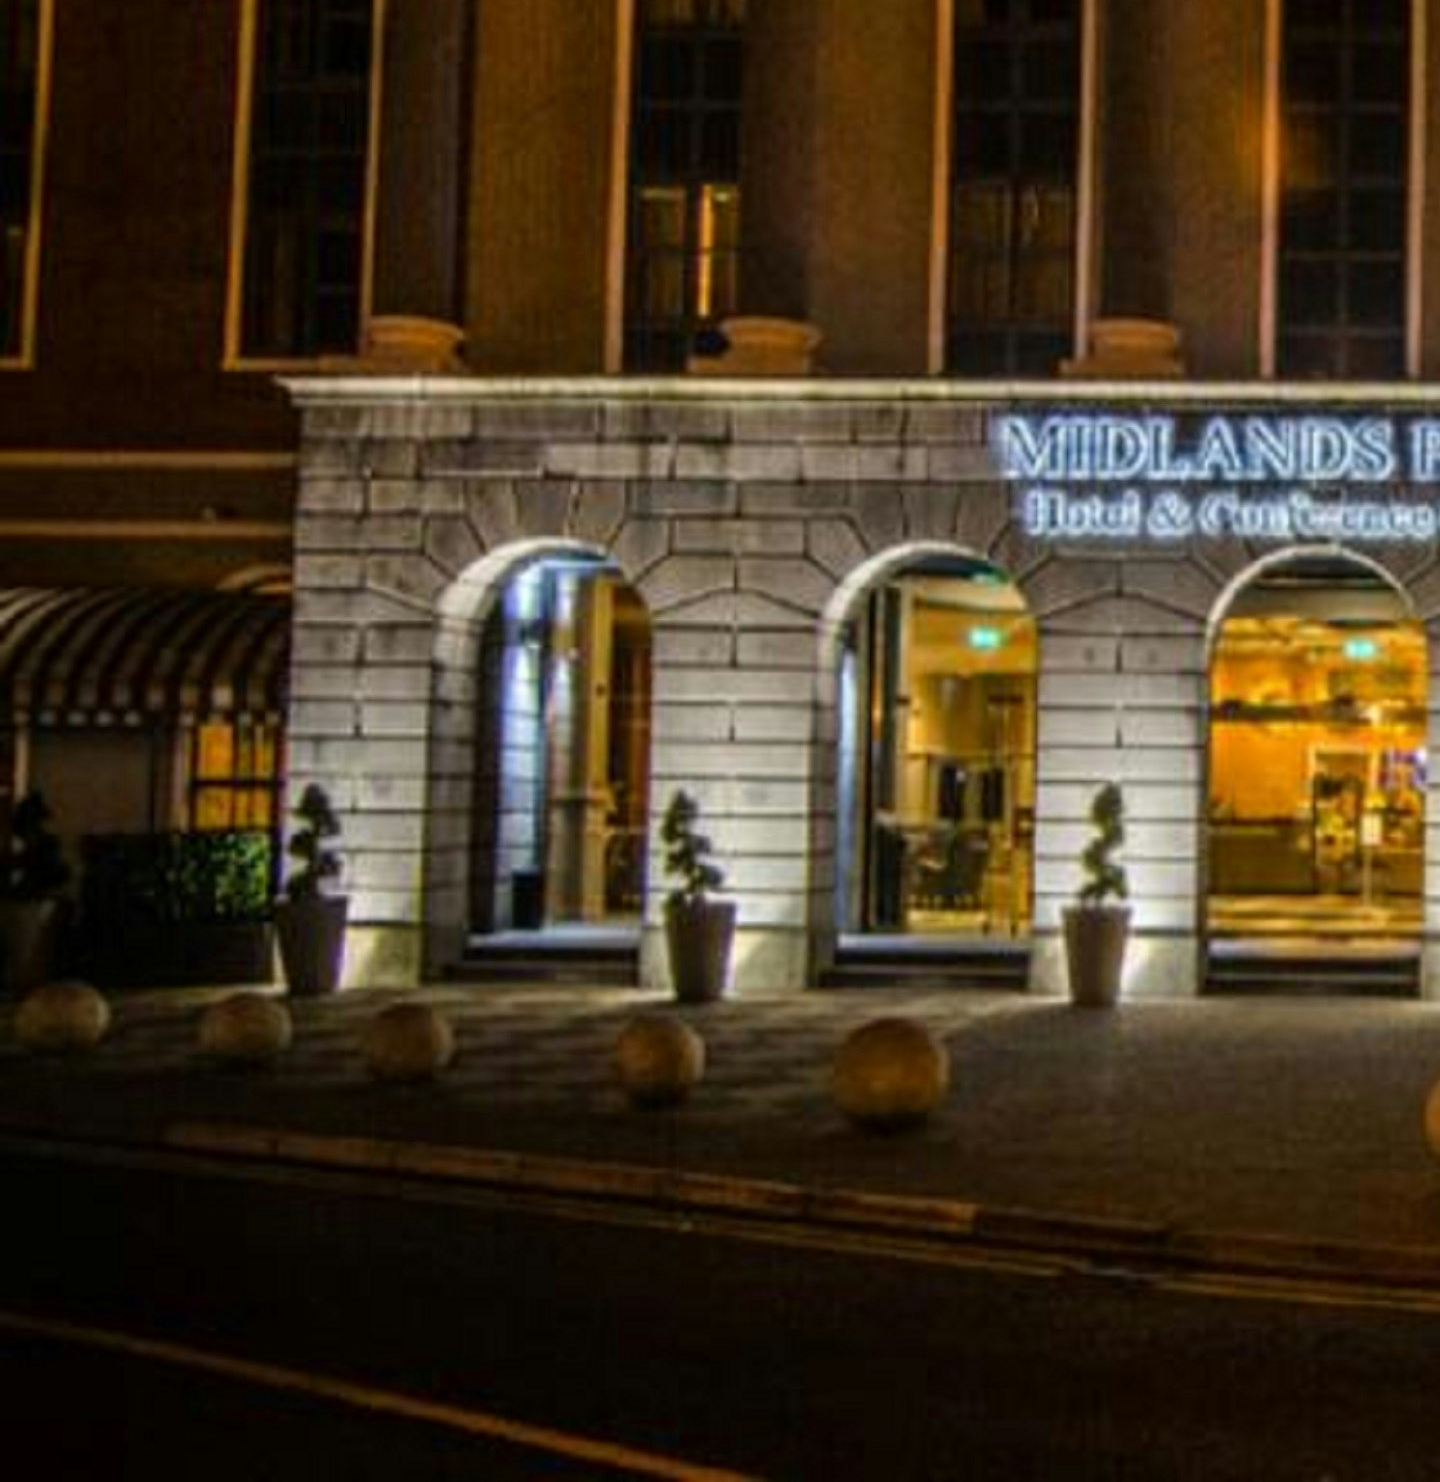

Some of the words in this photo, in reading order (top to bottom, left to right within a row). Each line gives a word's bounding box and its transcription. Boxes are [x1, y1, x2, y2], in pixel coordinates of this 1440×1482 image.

[1000, 415, 1396, 483] MIDLANDS
[1025, 487, 1142, 538] Hotel
[1147, 489, 1191, 538] &
